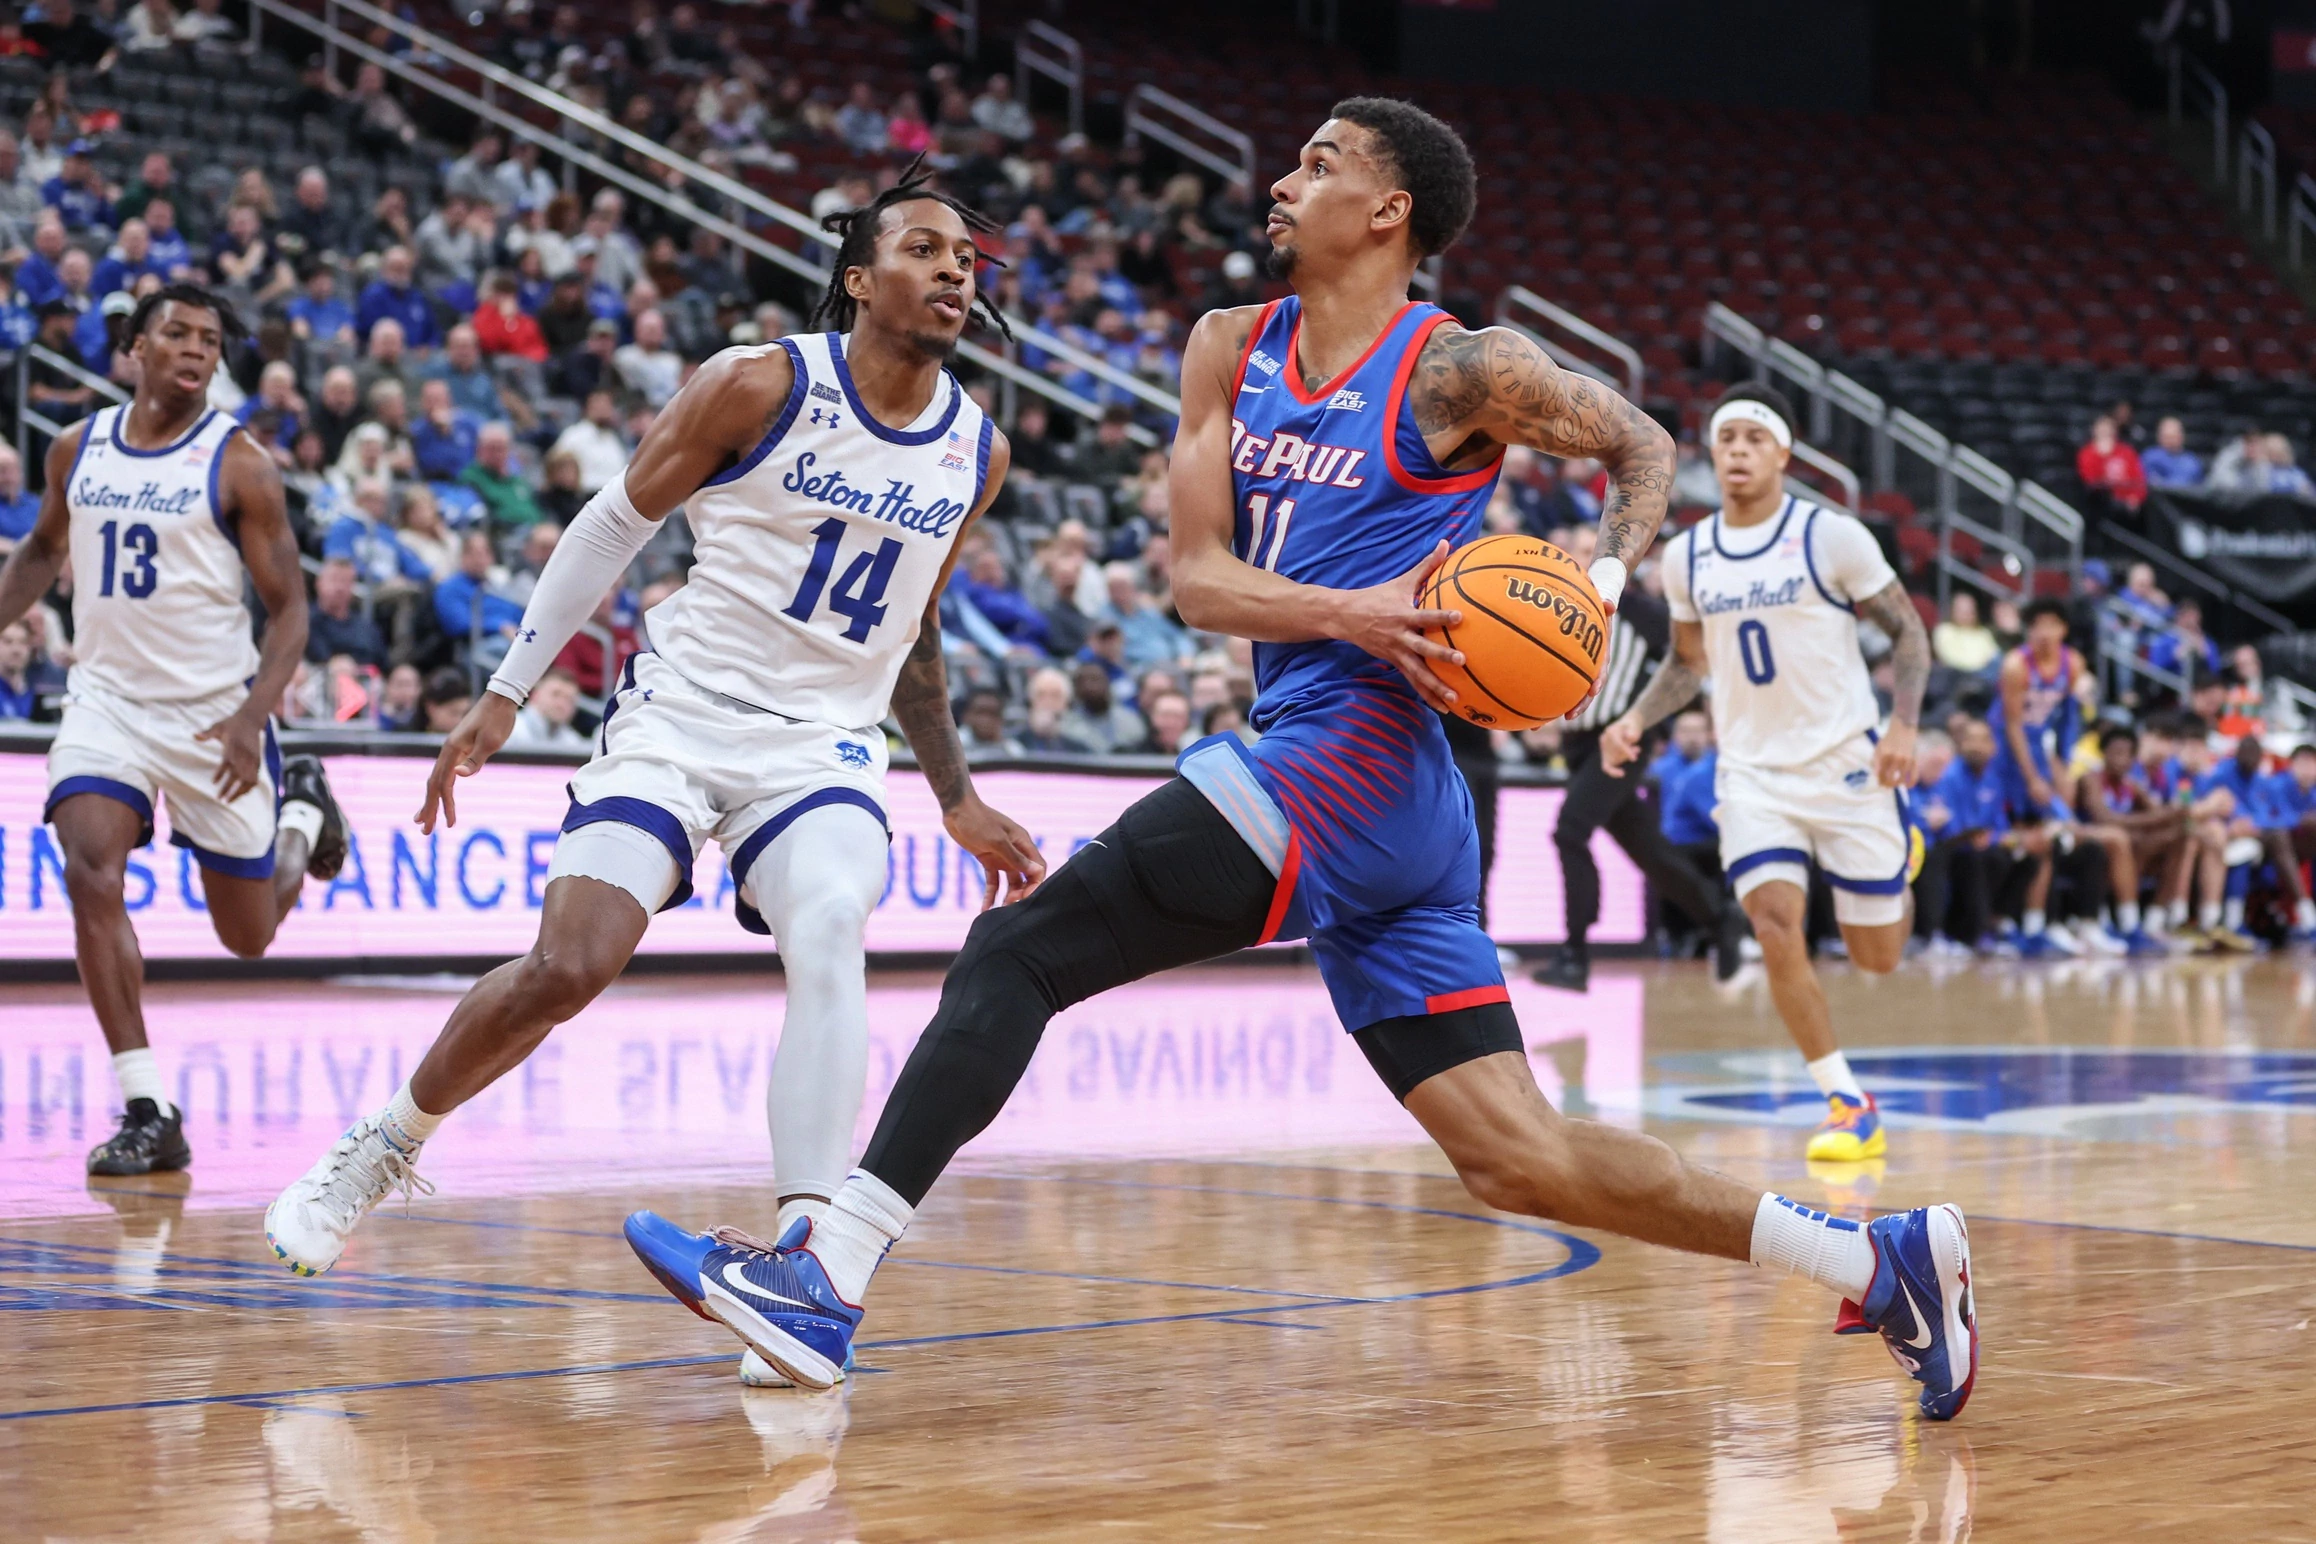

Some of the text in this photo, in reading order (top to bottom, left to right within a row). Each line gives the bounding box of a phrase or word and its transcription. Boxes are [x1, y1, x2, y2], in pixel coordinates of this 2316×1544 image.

[1249, 354, 1278, 377] CHANGE
[1253, 350, 1282, 370] BE THE
[810, 387, 842, 405] CHANGE
[815, 381, 841, 398] BE THE
[1329, 397, 1368, 409] EAST
[1335, 390, 1363, 400] BIG
[941, 459, 969, 472] EAST
[945, 453, 965, 464] BIG
[74, 477, 202, 515] Seton Hall
[783, 452, 965, 539] Seton Hall
[1246, 492, 1297, 573] 11
[97, 520, 158, 600] 13
[1514, 548, 1539, 556] NXT
[781, 517, 904, 645] 14
[1748, 576, 1805, 609] Hall
[1506, 577, 1604, 665] Wilson
[1737, 619, 1777, 687] 0
[0, 826, 558, 910] INSUANCE
